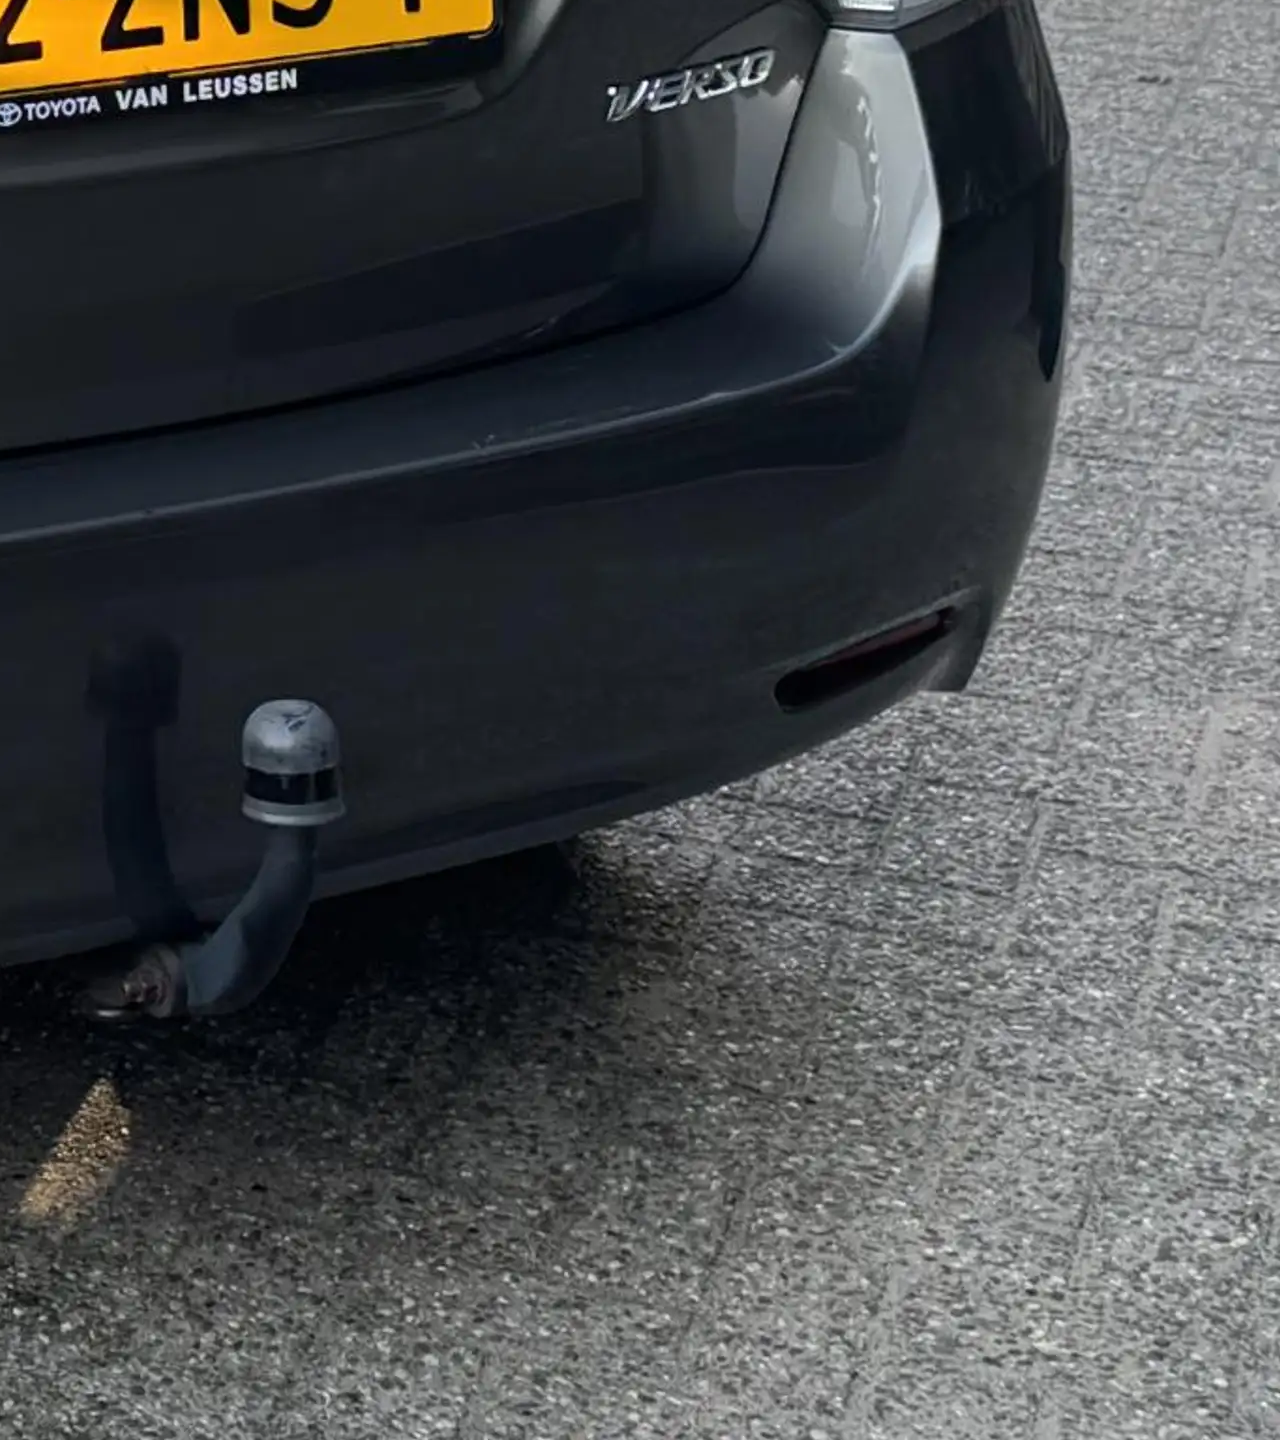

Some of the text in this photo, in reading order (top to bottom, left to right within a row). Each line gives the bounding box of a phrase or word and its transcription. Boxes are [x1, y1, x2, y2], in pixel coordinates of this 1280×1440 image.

[23, 68, 299, 122] TOYOTA VAN LEUSSEN
[605, 47, 778, 124] VERSO
